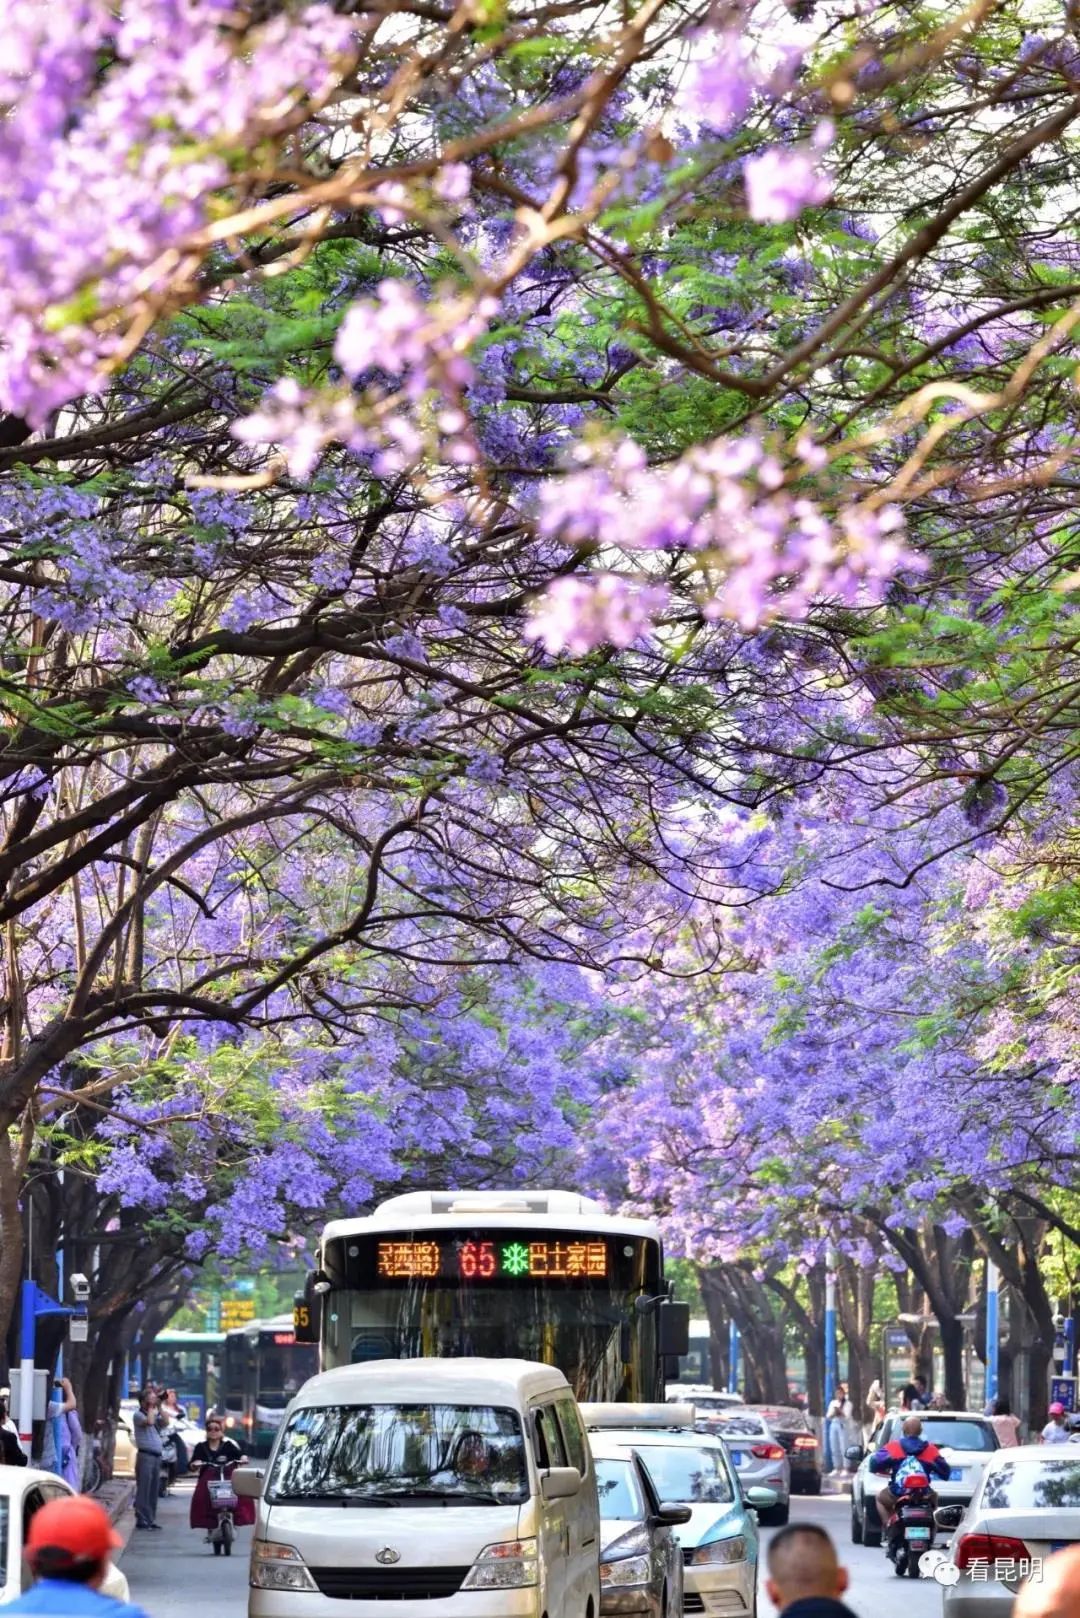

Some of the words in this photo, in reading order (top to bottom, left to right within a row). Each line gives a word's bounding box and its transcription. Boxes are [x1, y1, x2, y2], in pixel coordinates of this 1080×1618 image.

[461, 1242, 495, 1276] 65
[529, 1242, 606, 1276] 巴士家园
